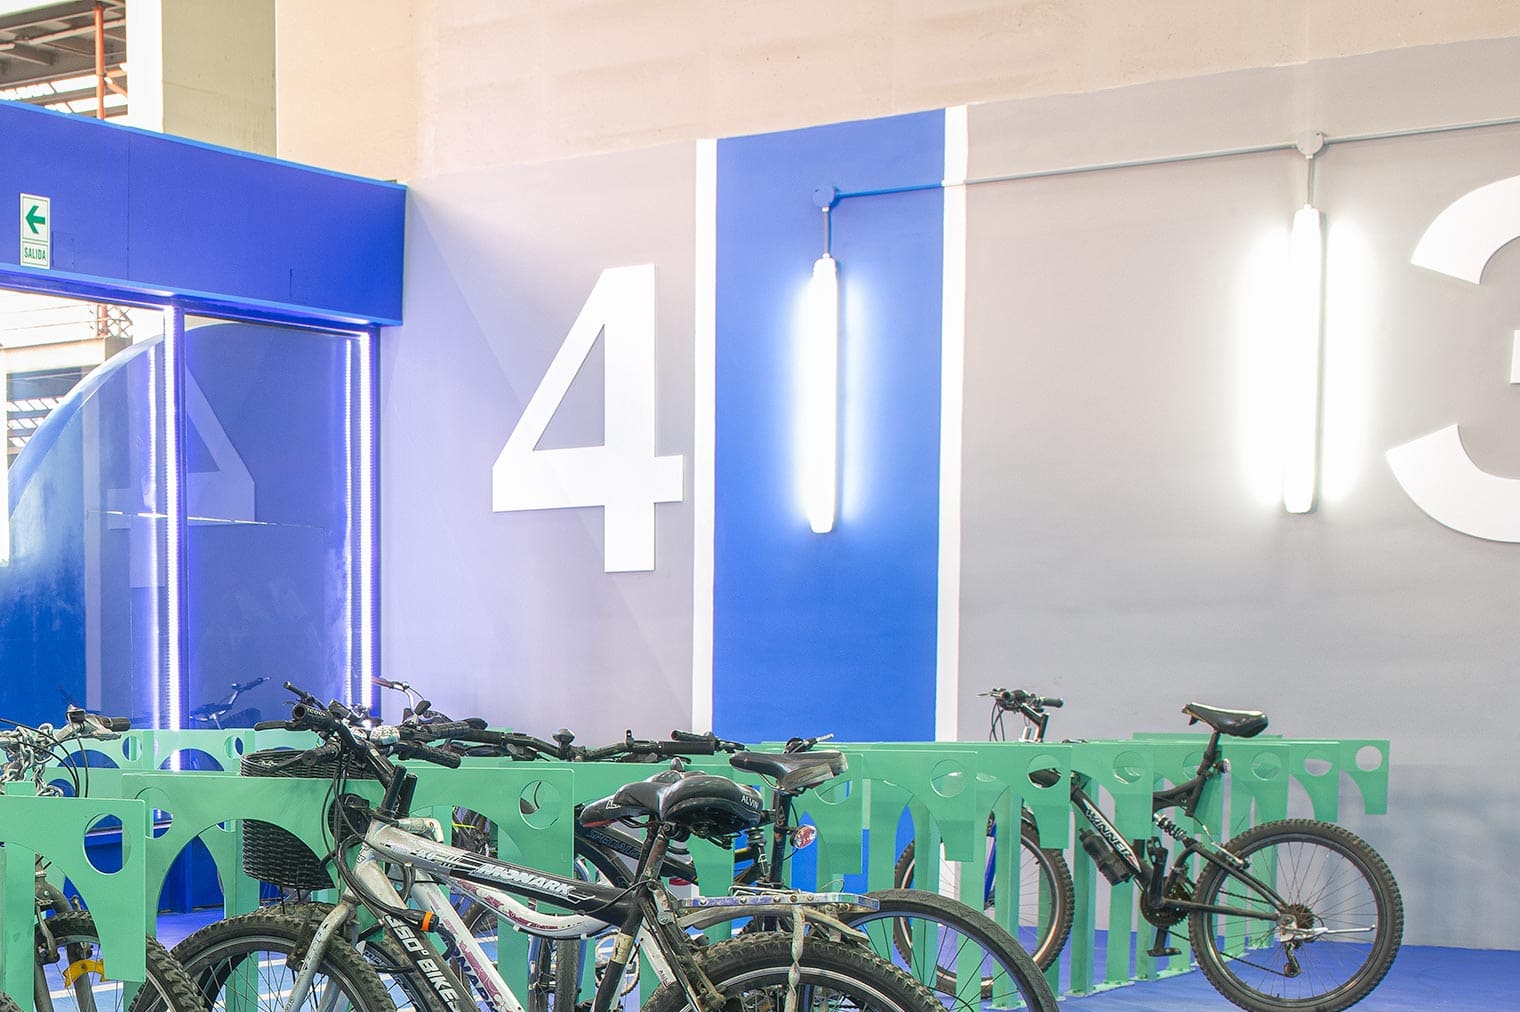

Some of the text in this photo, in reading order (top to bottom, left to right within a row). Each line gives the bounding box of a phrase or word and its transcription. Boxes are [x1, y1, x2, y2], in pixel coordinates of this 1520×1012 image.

[24, 247, 46, 261] SALIDA
[492, 263, 684, 574] 4
[1085, 808, 1133, 861] WINNER
[476, 863, 578, 897] MONARK
